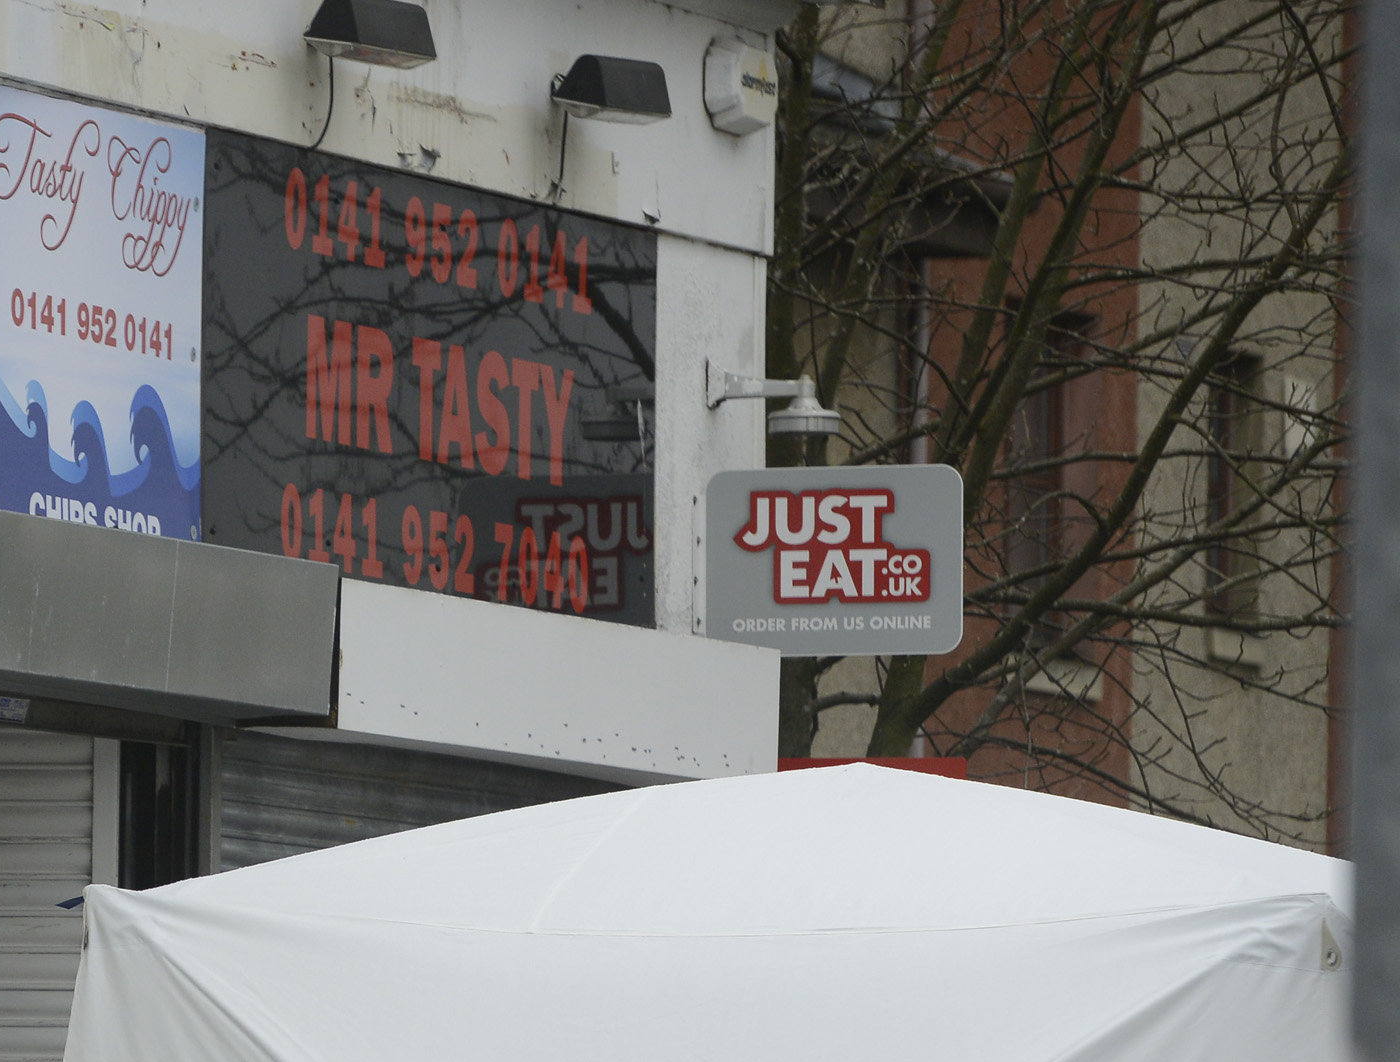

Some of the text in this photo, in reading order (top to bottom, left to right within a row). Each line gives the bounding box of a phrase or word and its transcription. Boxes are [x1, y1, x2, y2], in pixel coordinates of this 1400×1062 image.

[108, 135, 191, 277] Chippy
[285, 167, 592, 315] 0141 952 0141
[11, 288, 172, 361] 0141 952 0141
[306, 314, 575, 487] MR TASTY
[281, 482, 383, 578] 0141
[402, 505, 484, 594] 952
[495, 522, 588, 613] 7040
[742, 494, 889, 547] JUST
[732, 615, 931, 632] ORDER FROM US ONLINE
[780, 548, 888, 598] EAT
